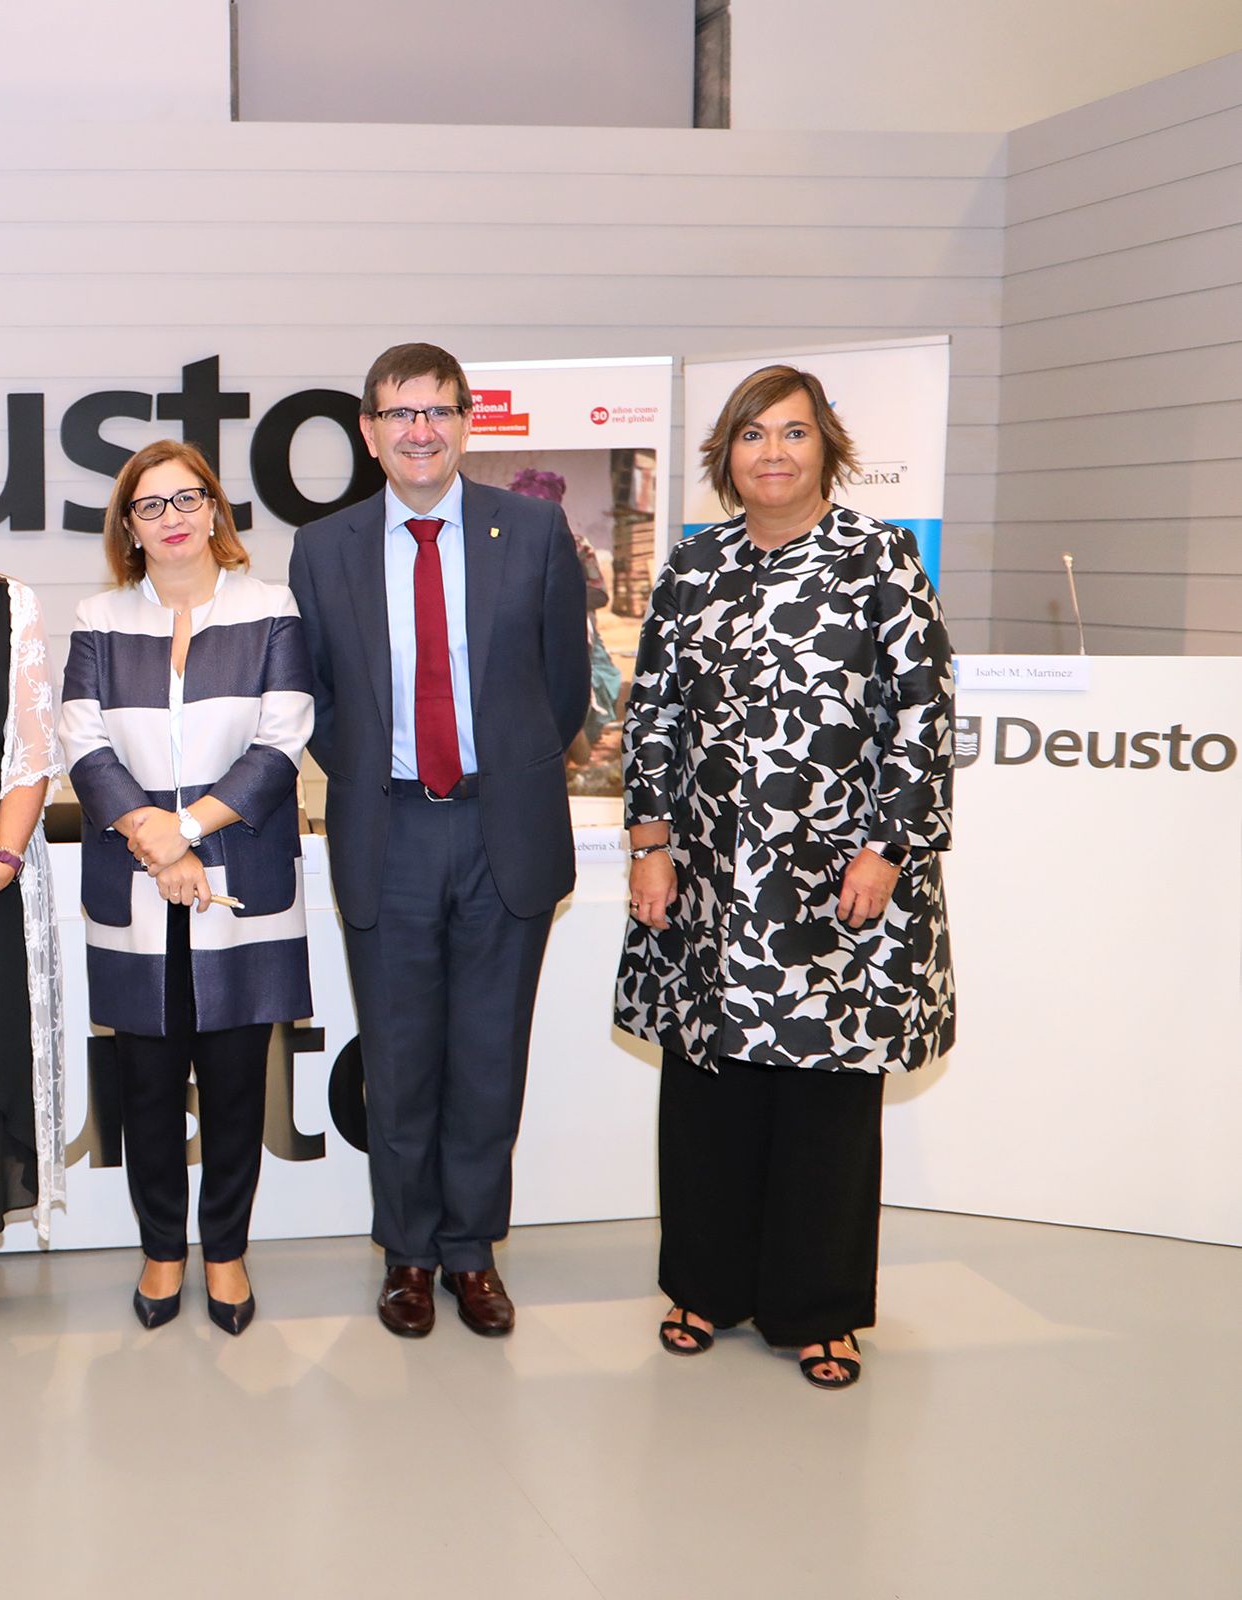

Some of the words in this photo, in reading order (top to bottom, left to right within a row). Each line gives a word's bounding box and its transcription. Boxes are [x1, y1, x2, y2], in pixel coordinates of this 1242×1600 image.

[592, 411, 607, 421] 30
[612, 414, 625, 422] red
[628, 414, 654, 424] global
[976, 668, 1006, 677] Isabel
[995, 717, 1237, 772] Deusto
